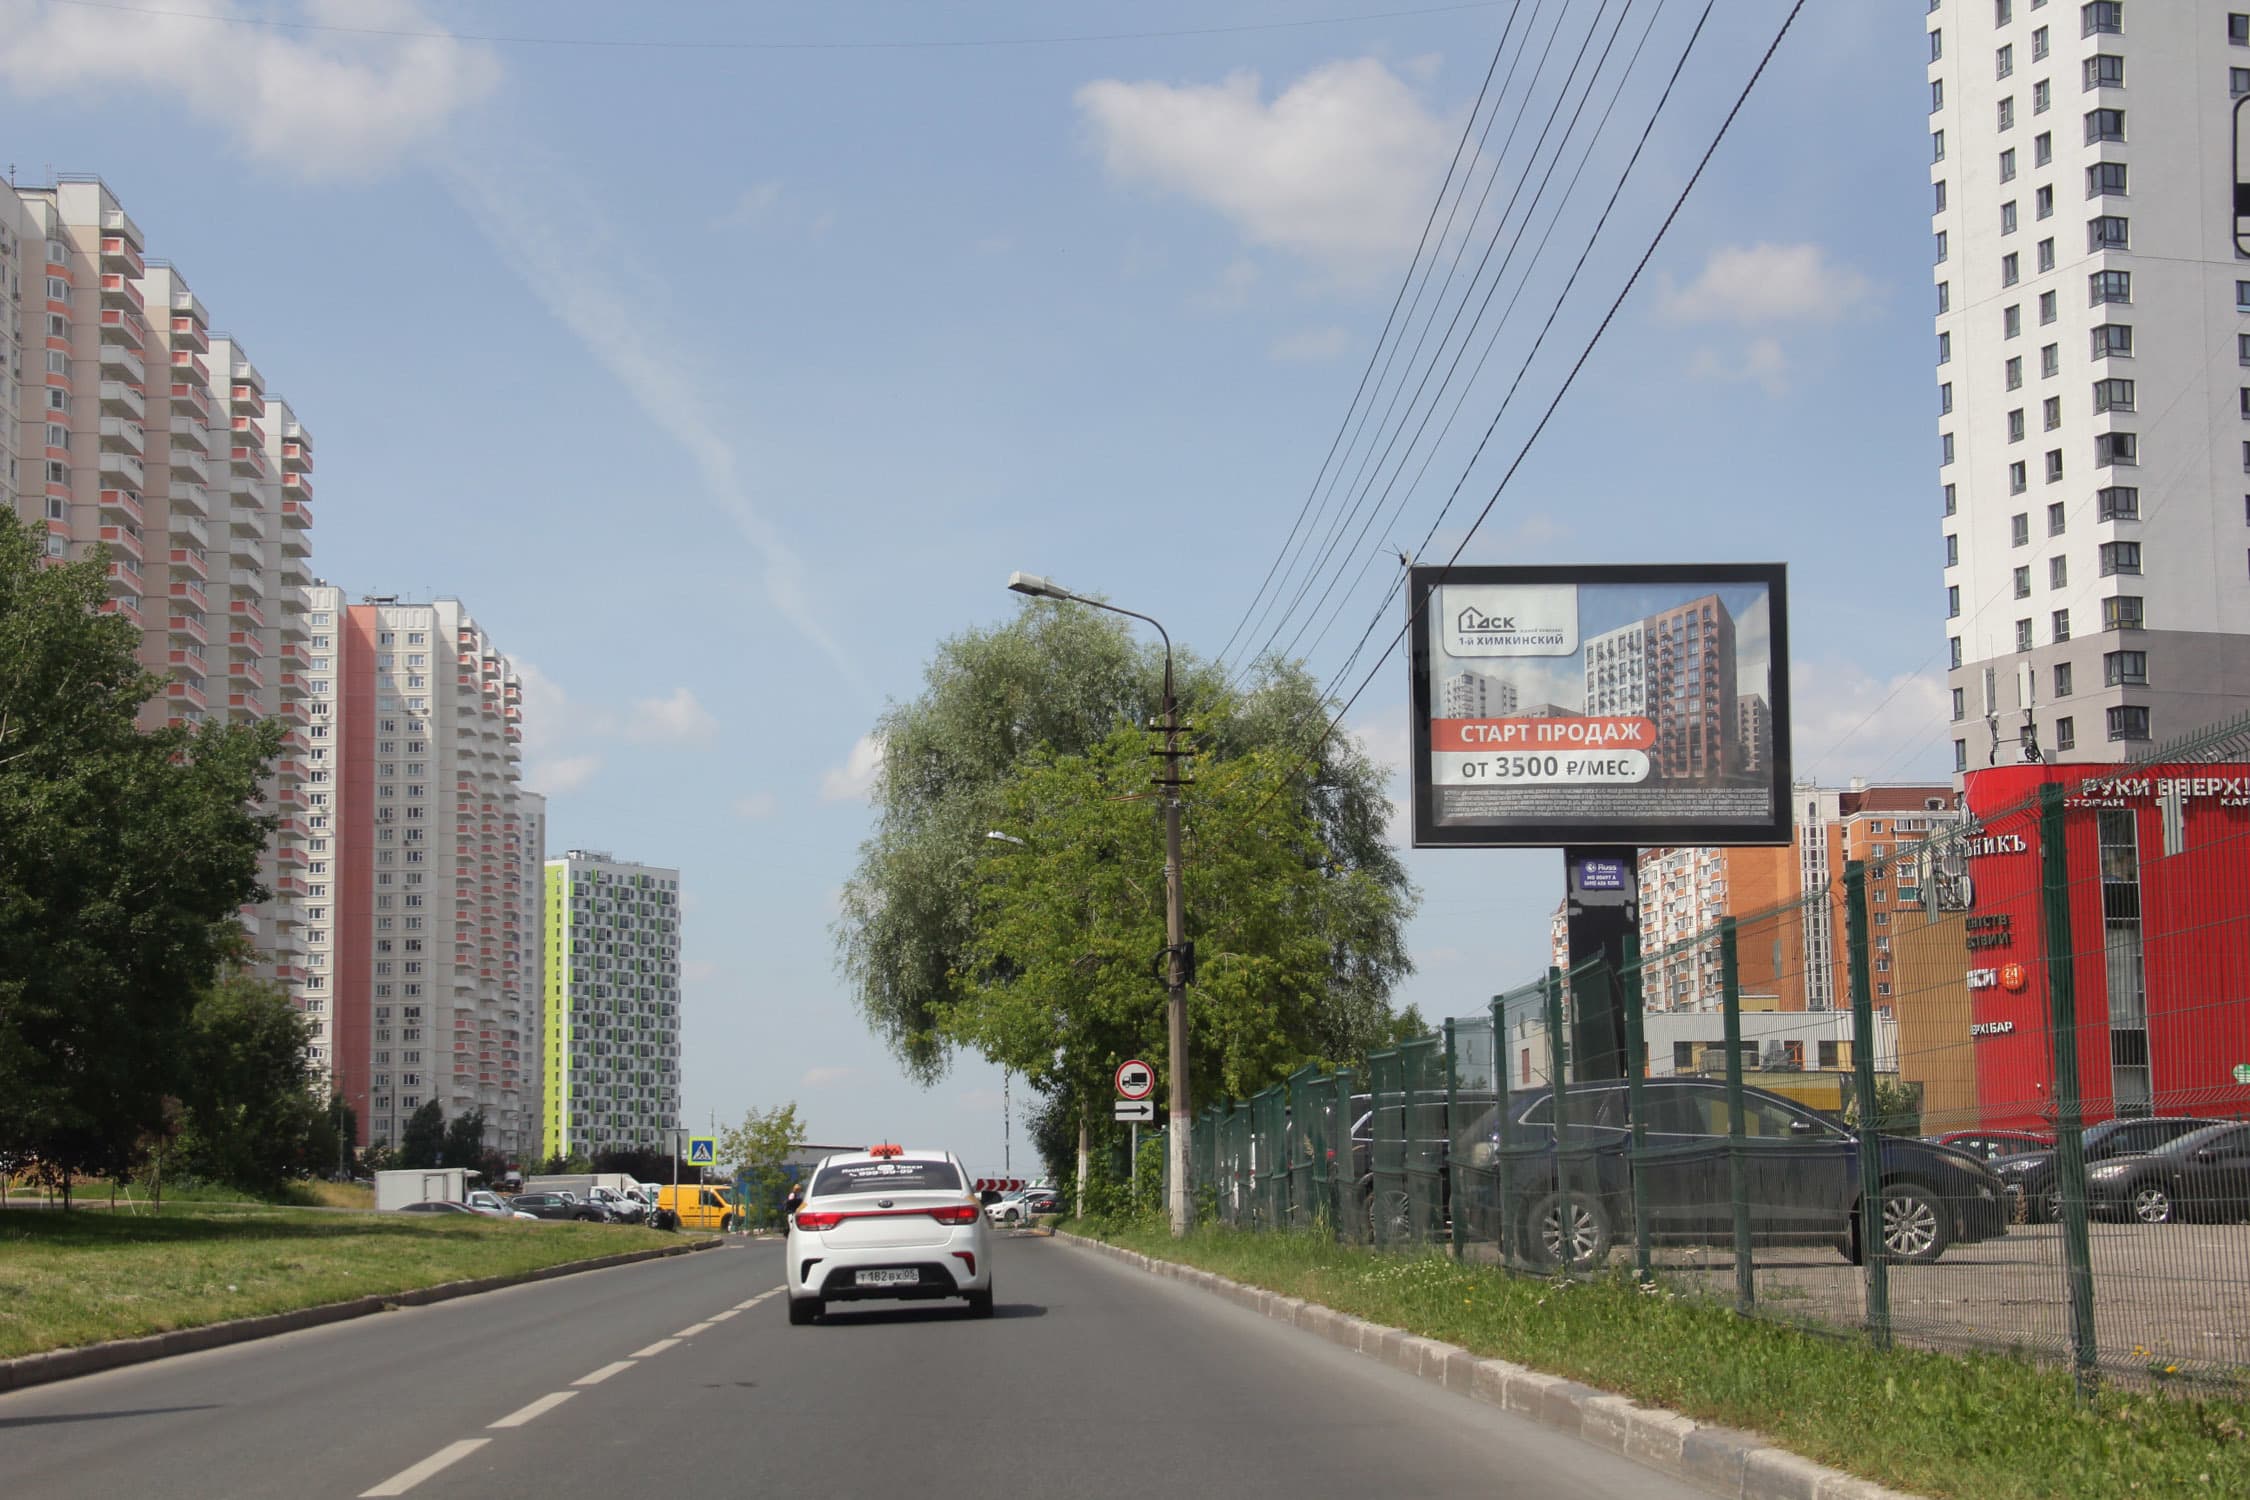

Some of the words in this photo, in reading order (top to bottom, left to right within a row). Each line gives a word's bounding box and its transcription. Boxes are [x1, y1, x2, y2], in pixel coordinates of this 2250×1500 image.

[1459, 636, 1474, 645] 1-й
[1476, 634, 1564, 645] ХИМКИНСКИЙ
[1461, 725, 1529, 742] СТАРТ
[1537, 724, 1642, 745] ПРОДАЖ
[1462, 762, 1488, 778] ОТ
[1495, 756, 1558, 777] 3500
[2082, 778, 2150, 796] РУКИ
